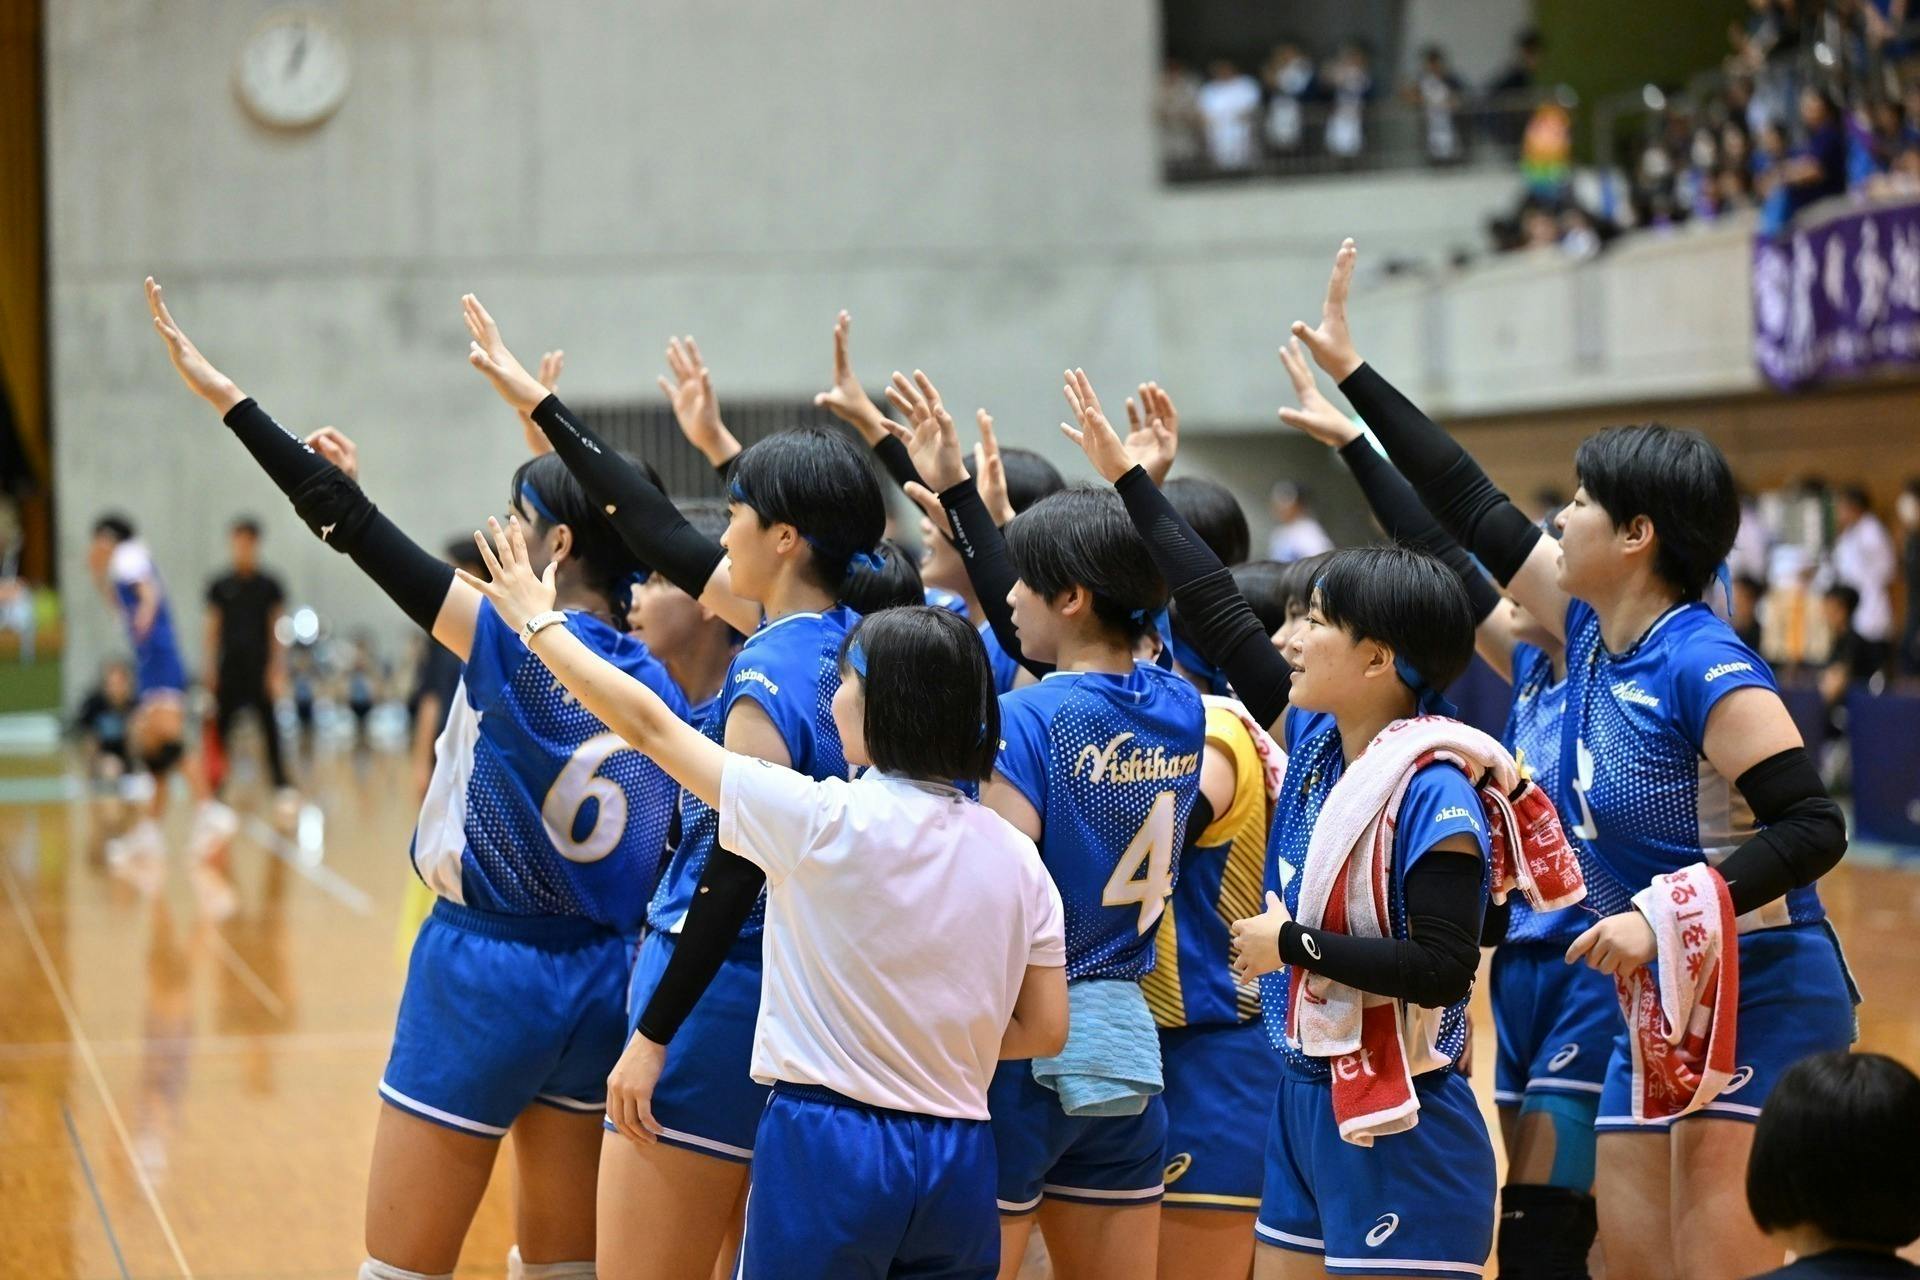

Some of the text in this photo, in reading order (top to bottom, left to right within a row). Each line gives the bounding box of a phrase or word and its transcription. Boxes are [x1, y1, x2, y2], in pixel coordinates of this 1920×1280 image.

[735, 668, 779, 695] okinawa
[541, 731, 632, 863] 6
[1073, 731, 1199, 784] Nishihara
[1101, 790, 1177, 936] 4
